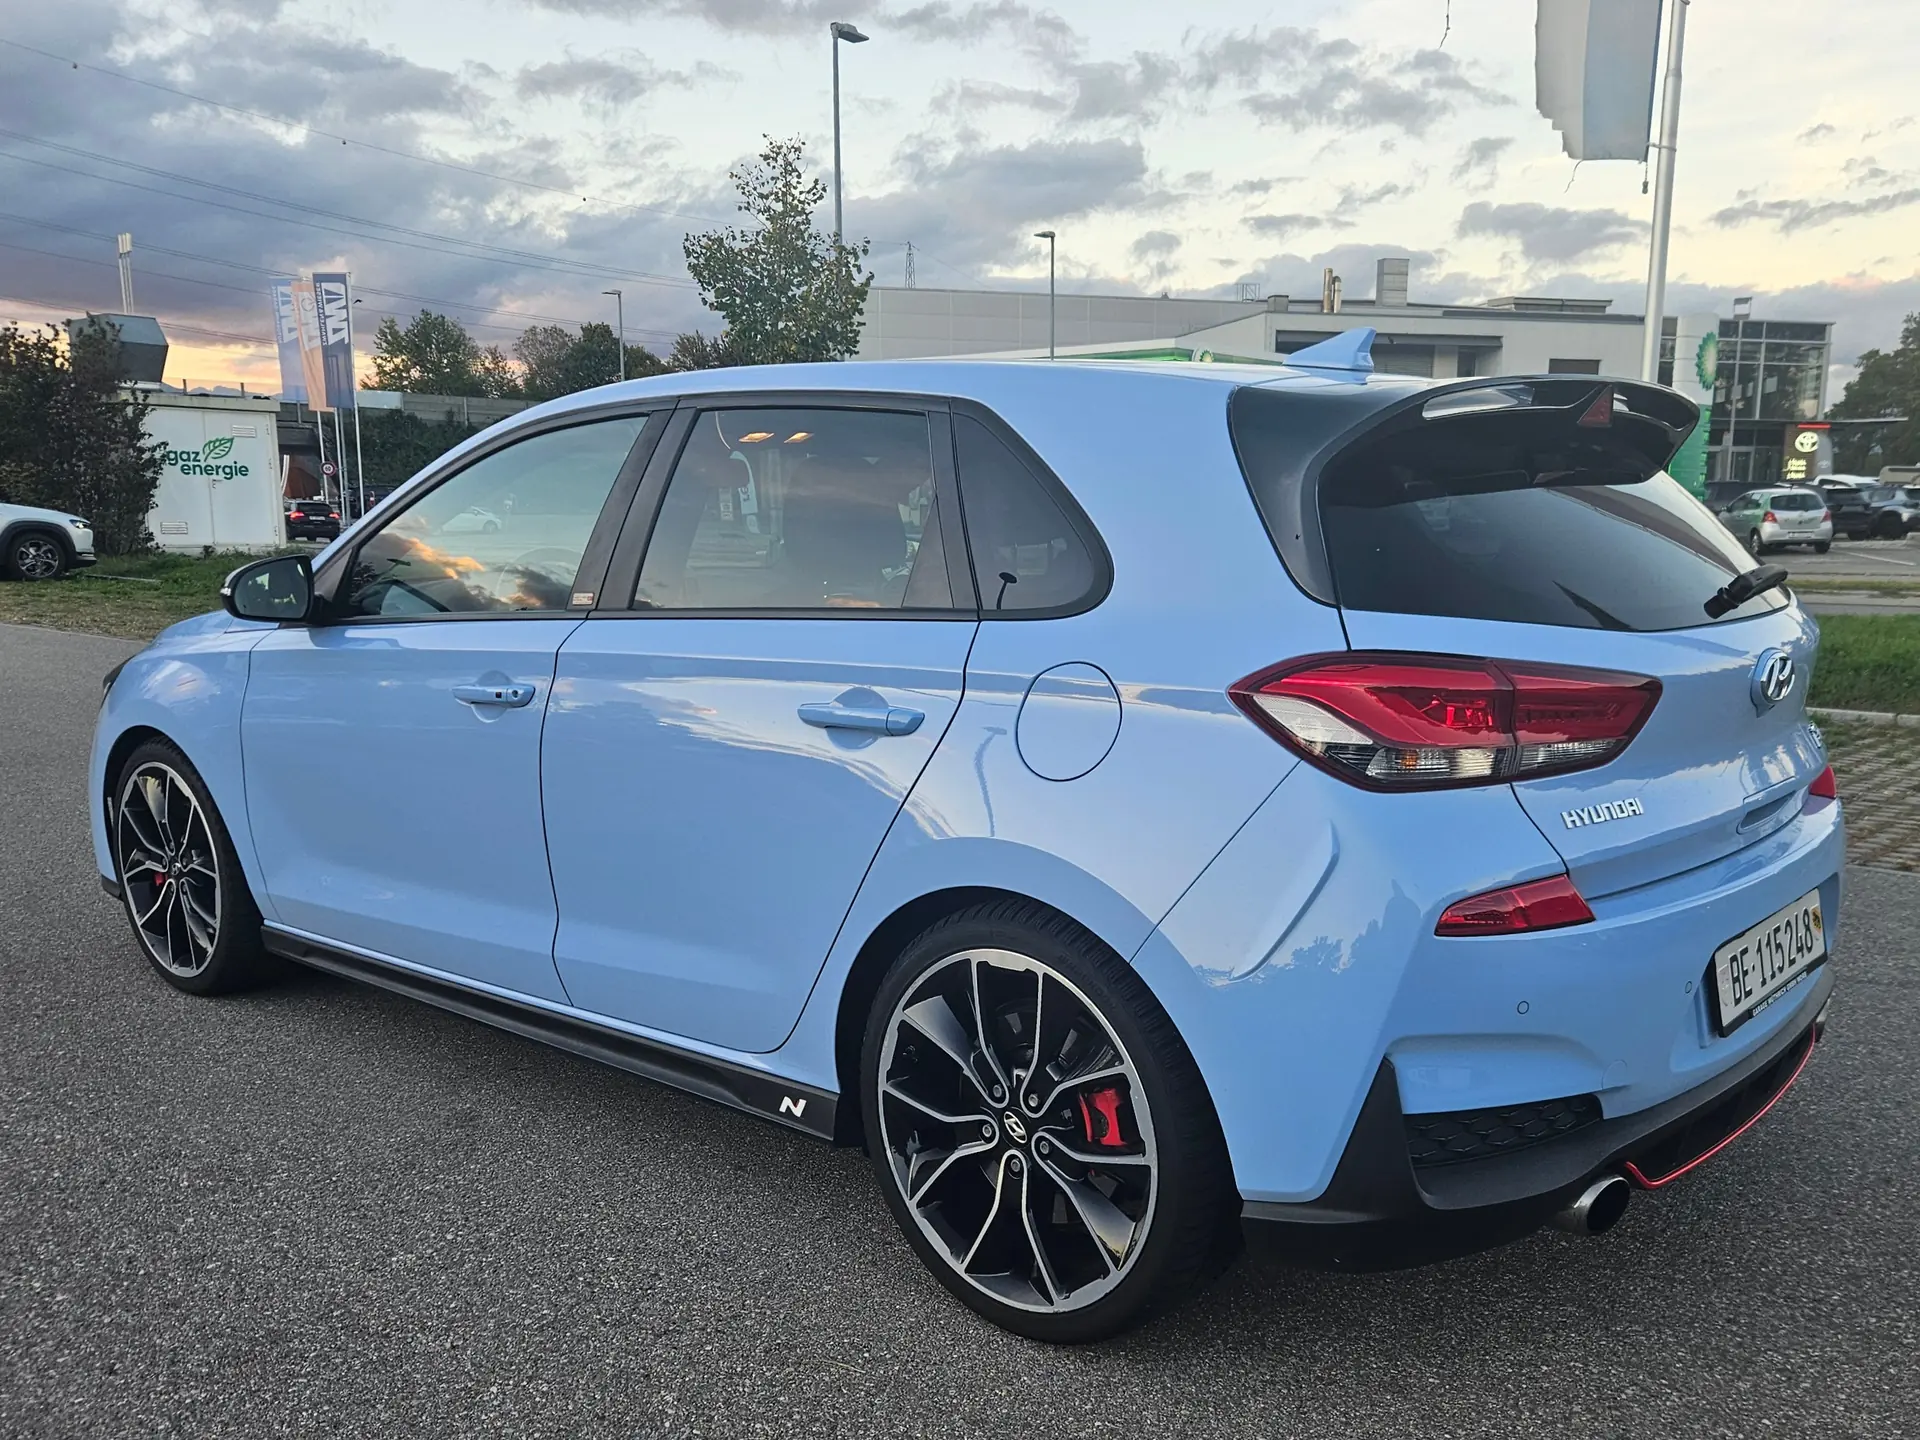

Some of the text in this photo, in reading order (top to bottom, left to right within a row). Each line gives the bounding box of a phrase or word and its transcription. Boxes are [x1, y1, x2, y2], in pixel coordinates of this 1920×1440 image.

[166, 450, 201, 466] gaz
[180, 460, 249, 481] energie
[1560, 797, 1644, 829] HYUNDAI
[779, 1095, 807, 1118] N
